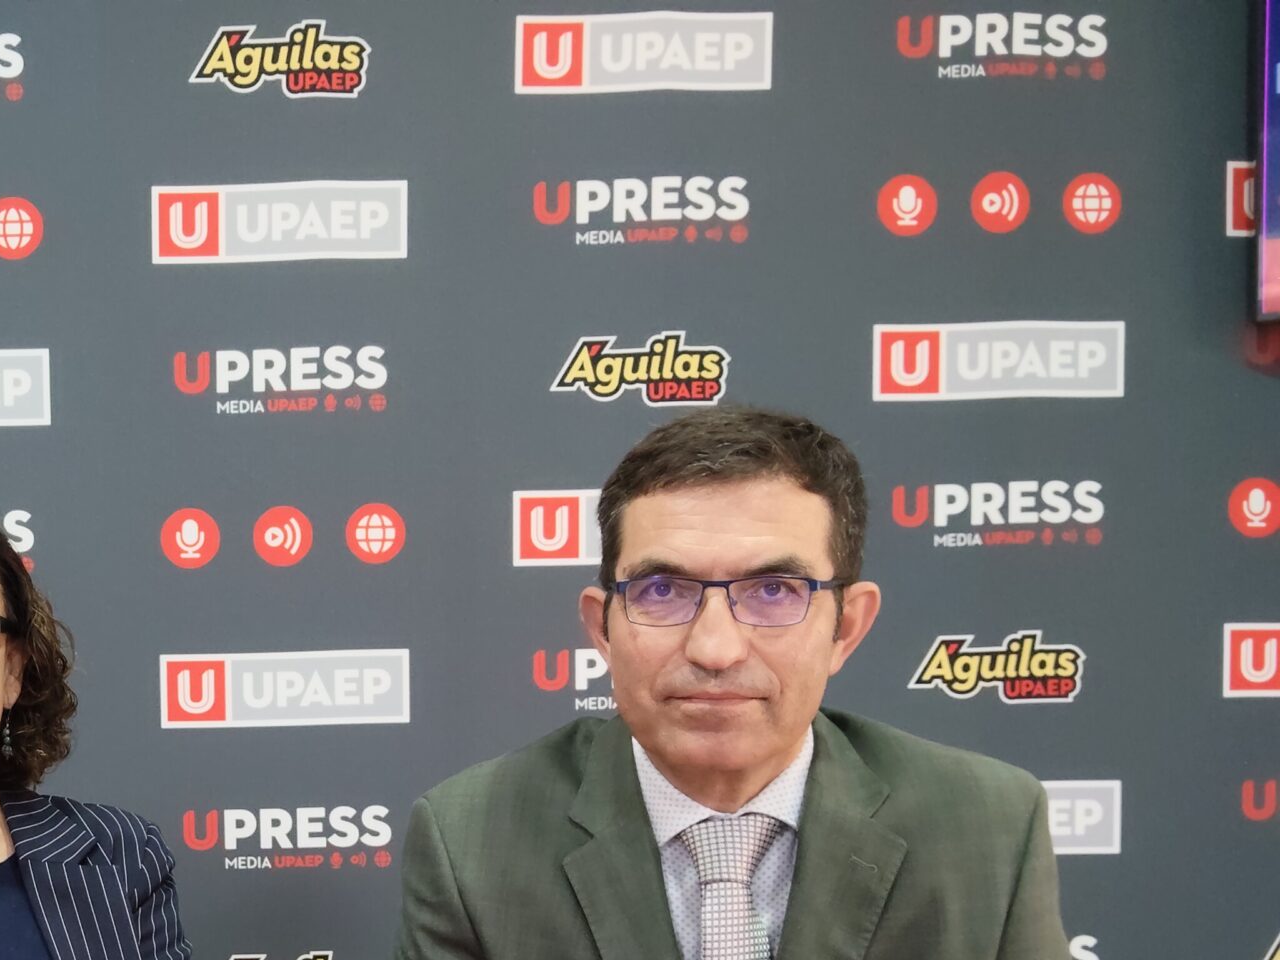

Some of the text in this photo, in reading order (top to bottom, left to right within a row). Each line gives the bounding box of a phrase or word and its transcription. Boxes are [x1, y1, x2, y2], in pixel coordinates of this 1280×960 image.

[601, 32, 753, 72] UPAEP
[897, 12, 1107, 57] UPRESS
[204, 28, 360, 85] Águilas
[939, 60, 1037, 77] MEDIA UPAEP
[288, 70, 360, 92] UPAEP
[534, 176, 749, 224] UPRESS
[237, 201, 388, 242] UPAEP
[576, 226, 678, 244] MEDIA UPAEP
[174, 345, 387, 394] UPRESS
[565, 339, 720, 394] Águilas
[958, 341, 1106, 380] UPAEP
[217, 395, 318, 414] MEDIA UPAEP
[649, 379, 719, 400] UPAEP
[892, 481, 1104, 527] UPRESS
[934, 530, 1036, 546] MEDIA UPAEP
[922, 638, 1075, 691] Águilas
[243, 669, 391, 708] UPAEP
[1004, 676, 1074, 699] UPAEP
[183, 805, 391, 850] UPRESS
[225, 854, 323, 869] MEDIA UPAEP
